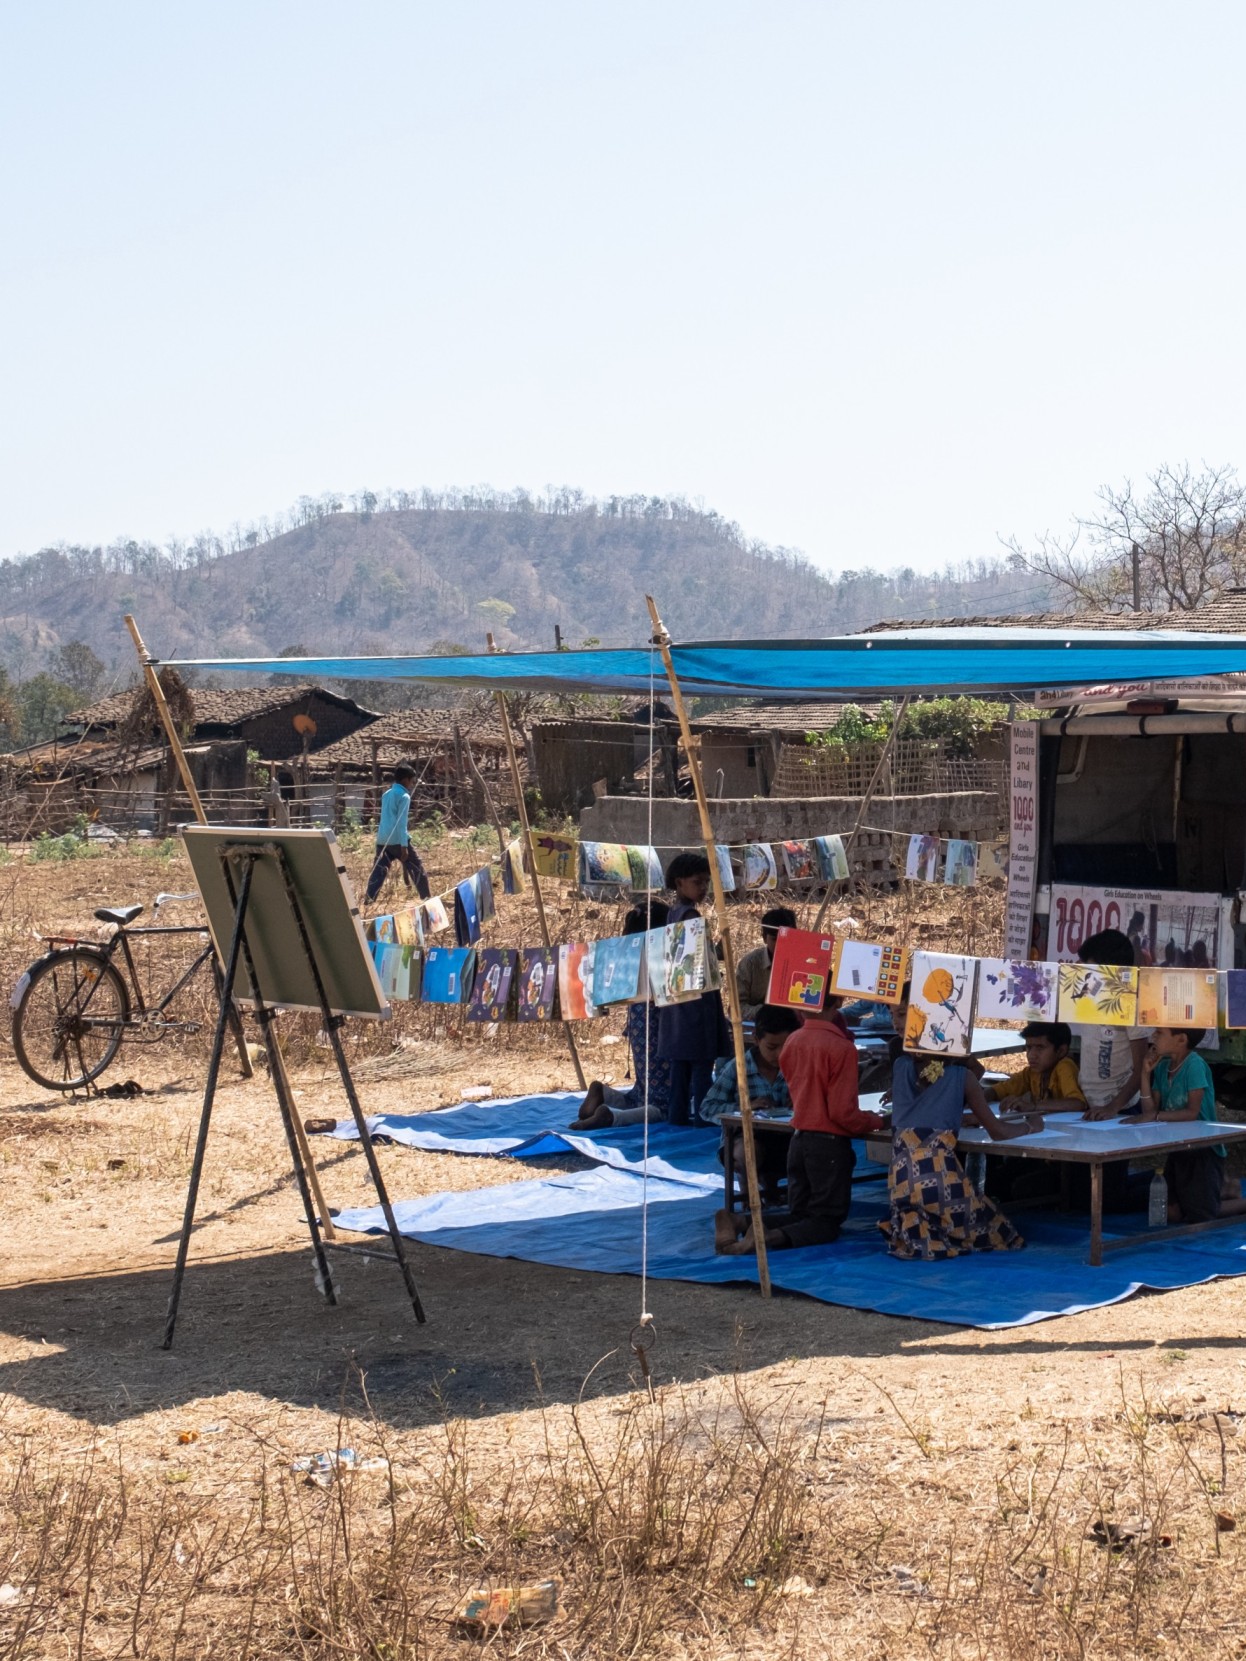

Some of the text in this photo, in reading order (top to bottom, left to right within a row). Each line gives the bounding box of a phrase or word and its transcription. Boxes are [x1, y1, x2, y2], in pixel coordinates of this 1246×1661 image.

[1117, 683, 1148, 699] you
[1013, 727, 1034, 738] Mobile
[1014, 743, 1035, 755] Centre
[1016, 761, 1030, 771] and
[1013, 777, 1033, 791] Libary
[1013, 796, 1034, 821] 1000
[1017, 843, 1029, 852] Girls
[1011, 853, 1034, 862] Education
[1013, 873, 1030, 883] Wheels
[1104, 889, 1114, 898] Girls
[1114, 890, 1137, 899] Education
[1144, 892, 1162, 900] Wheels
